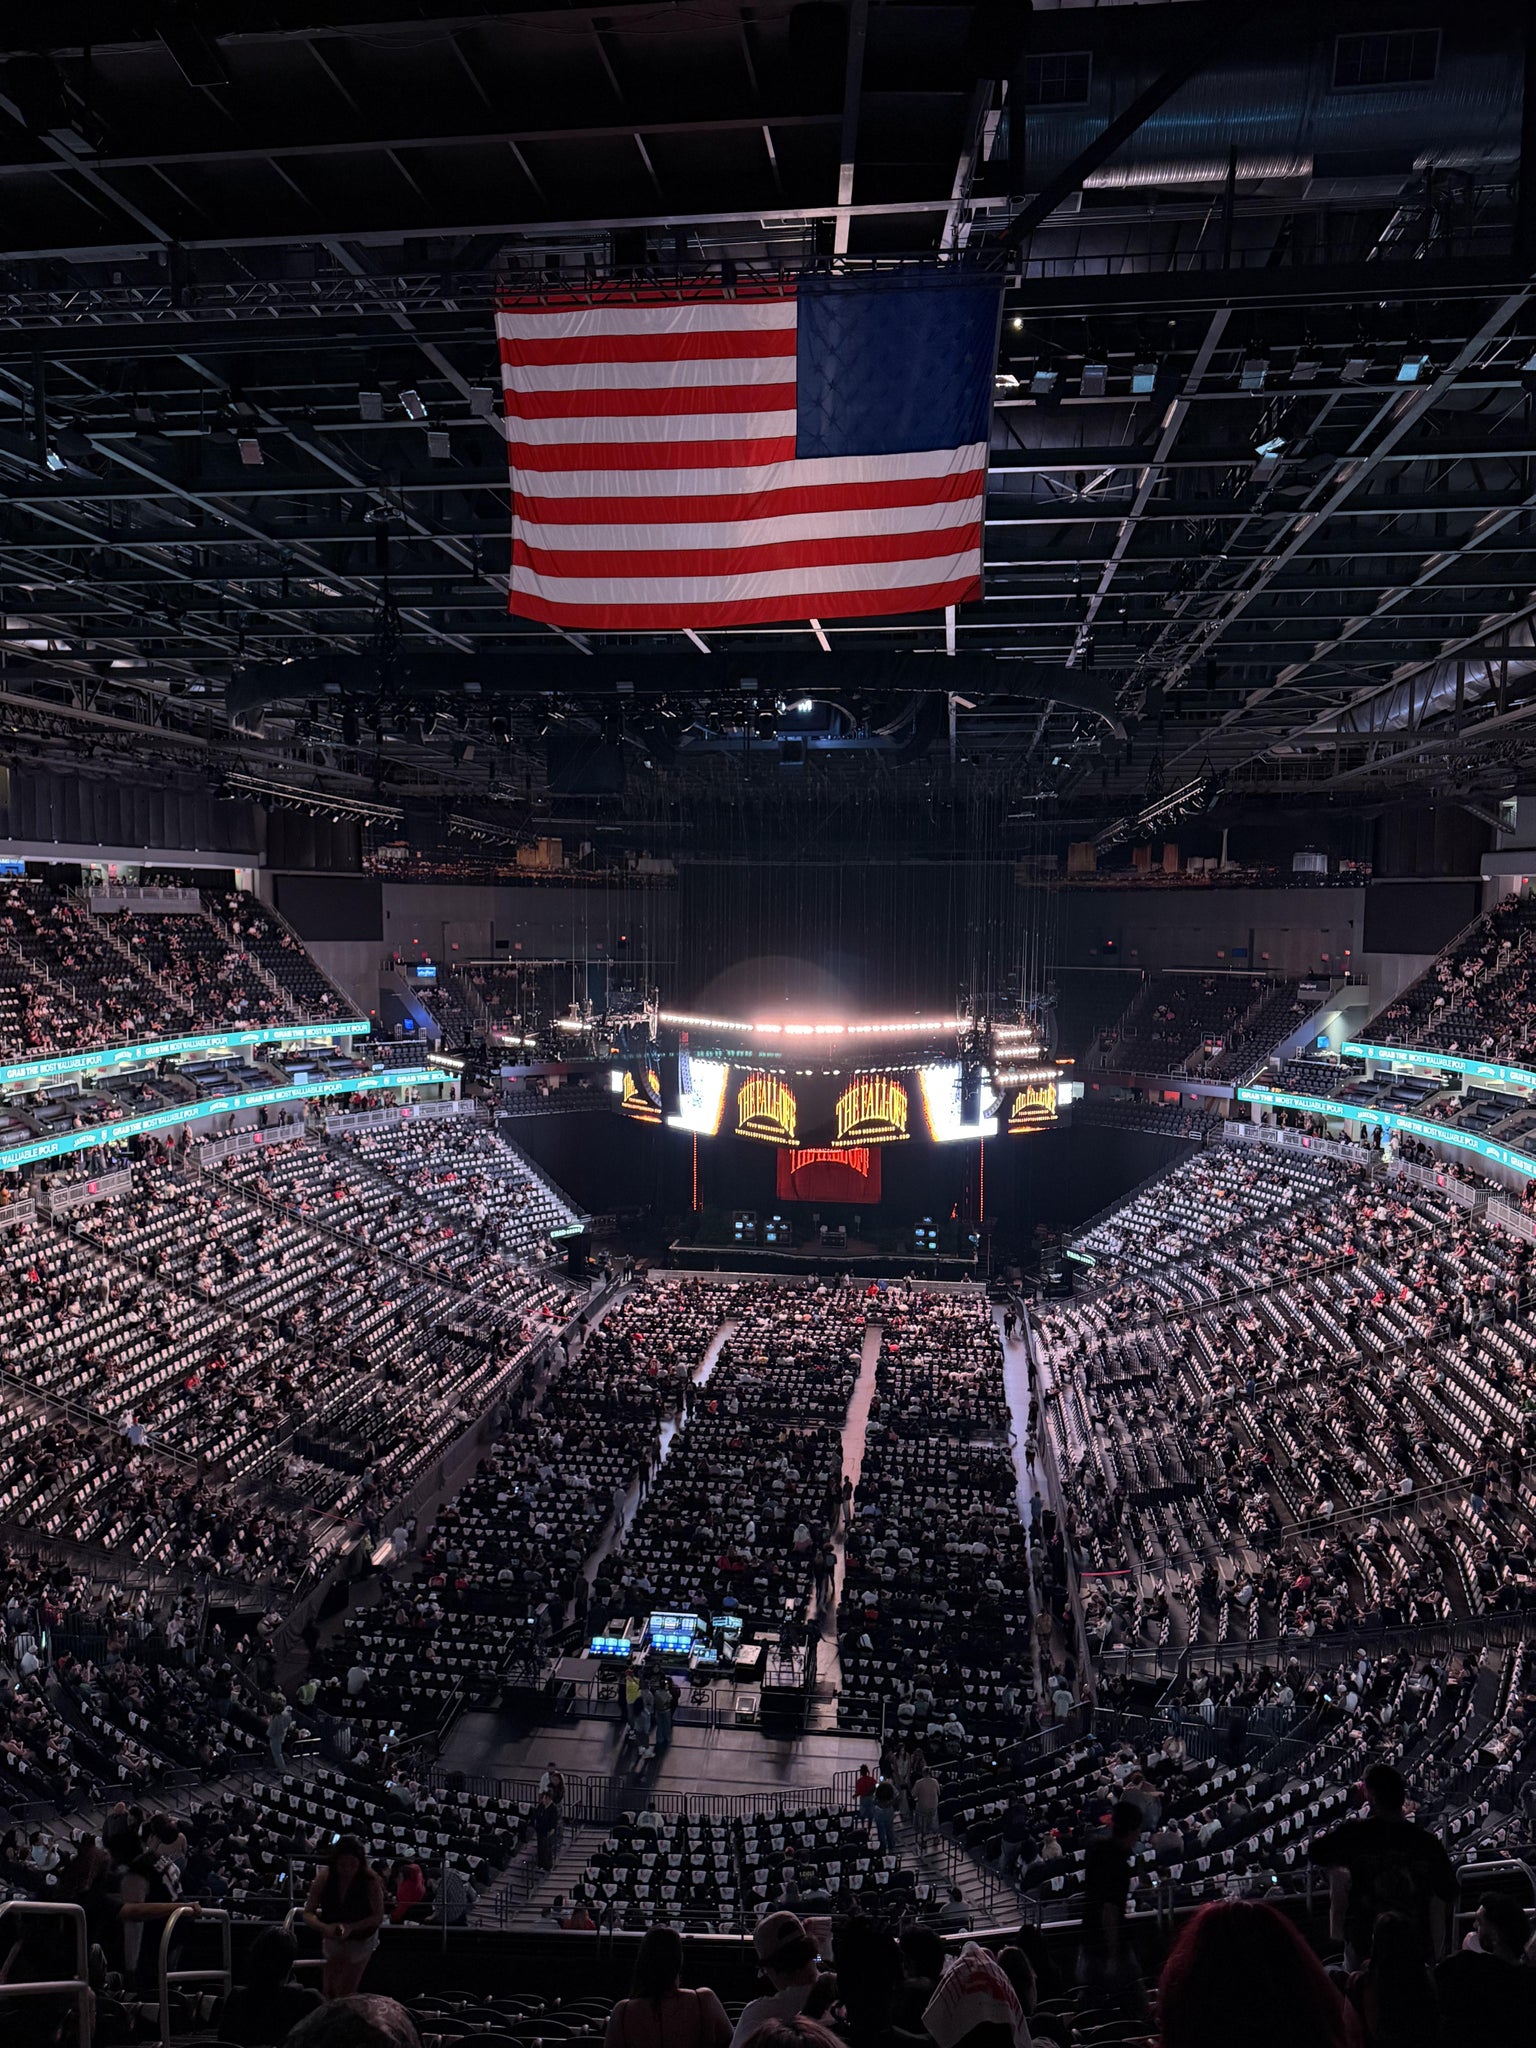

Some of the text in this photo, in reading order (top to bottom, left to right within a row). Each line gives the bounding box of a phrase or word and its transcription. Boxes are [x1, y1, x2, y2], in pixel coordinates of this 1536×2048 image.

[1242, 1092, 1343, 1114] GRAB THE MOST VALUABLE POUR
[2, 1143, 58, 1165] VALUABLE POUR
